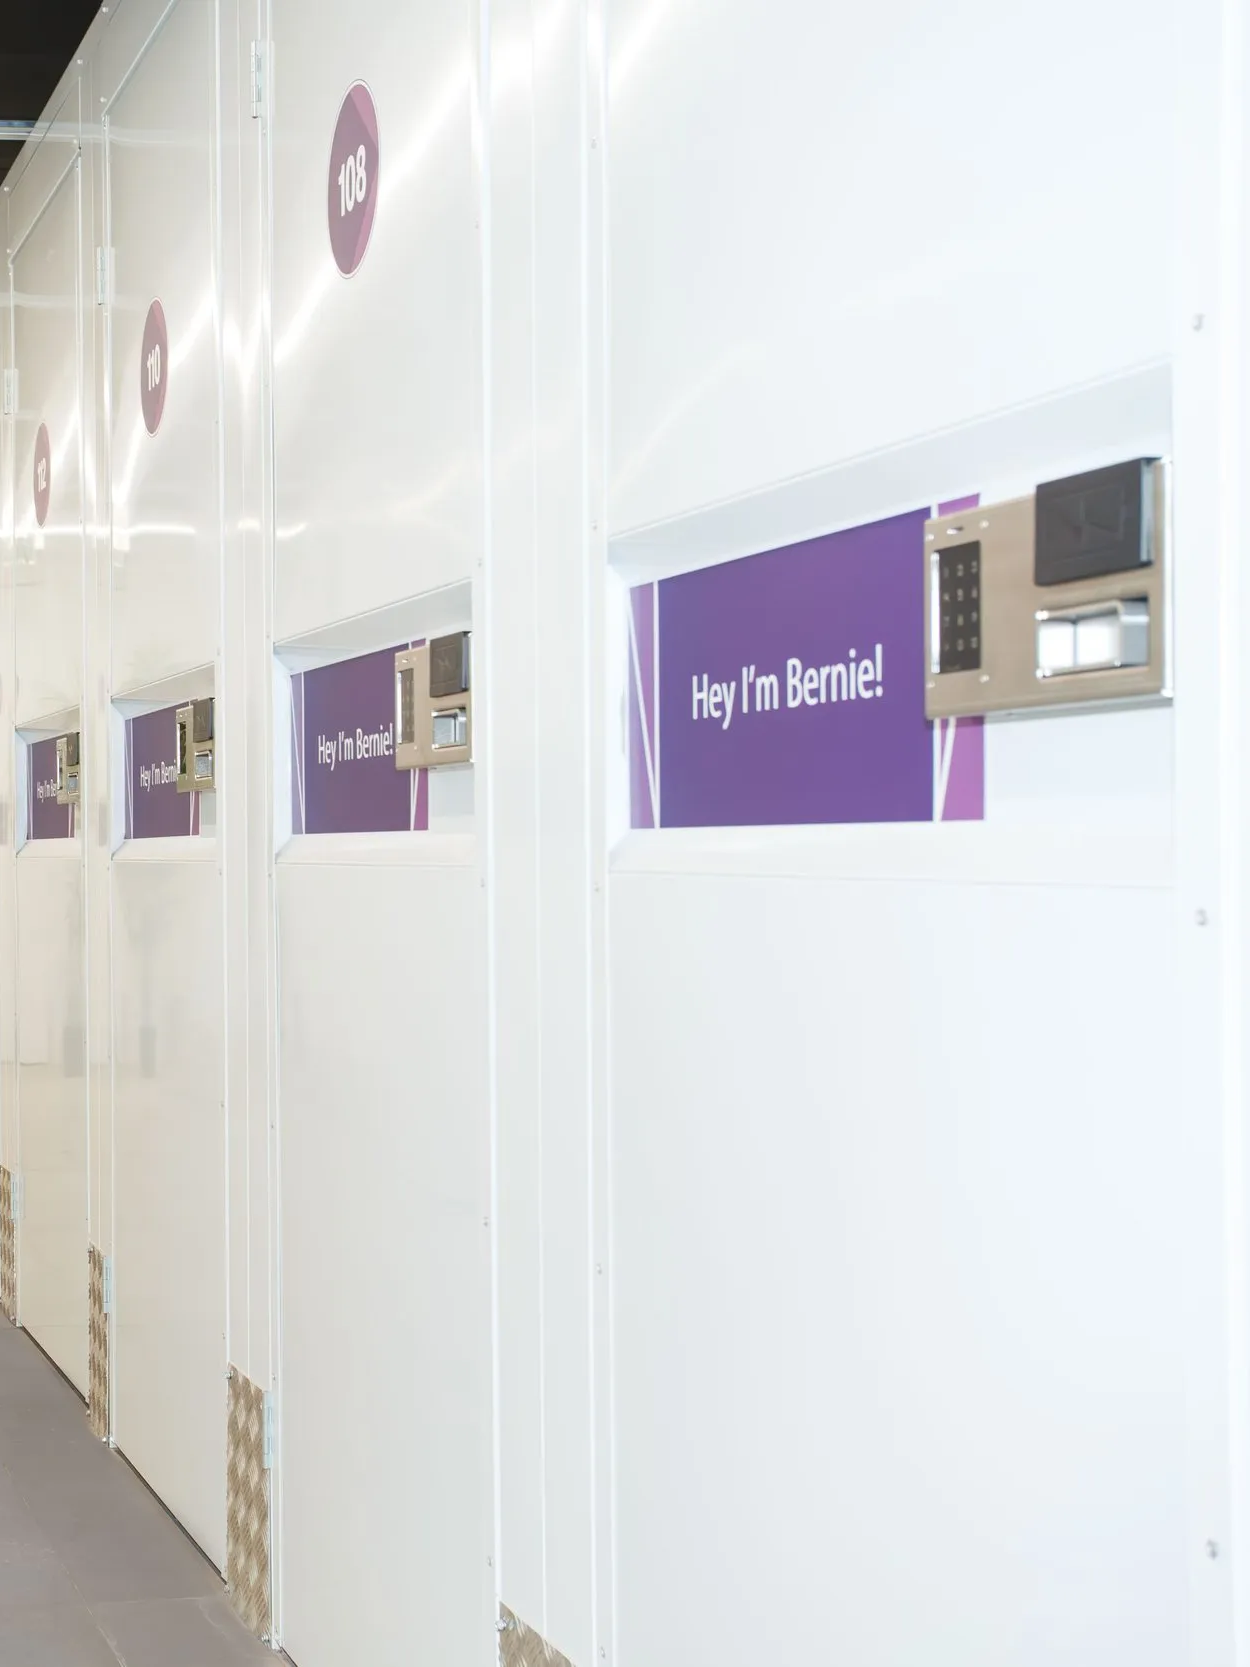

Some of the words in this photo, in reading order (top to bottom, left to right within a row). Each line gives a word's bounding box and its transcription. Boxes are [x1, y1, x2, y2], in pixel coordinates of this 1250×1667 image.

[338, 144, 367, 217] 108
[146, 343, 161, 391] 110
[37, 457, 46, 492] 112
[692, 672, 736, 730] Hey
[742, 664, 779, 714] I'm
[786, 643, 884, 708] Bernie!
[318, 734, 337, 771] Hey
[338, 731, 354, 761] I'm
[356, 722, 393, 760] Bernie!
[140, 765, 151, 792] Hey
[151, 763, 161, 785] I'm
[161, 759, 178, 784] Berni
